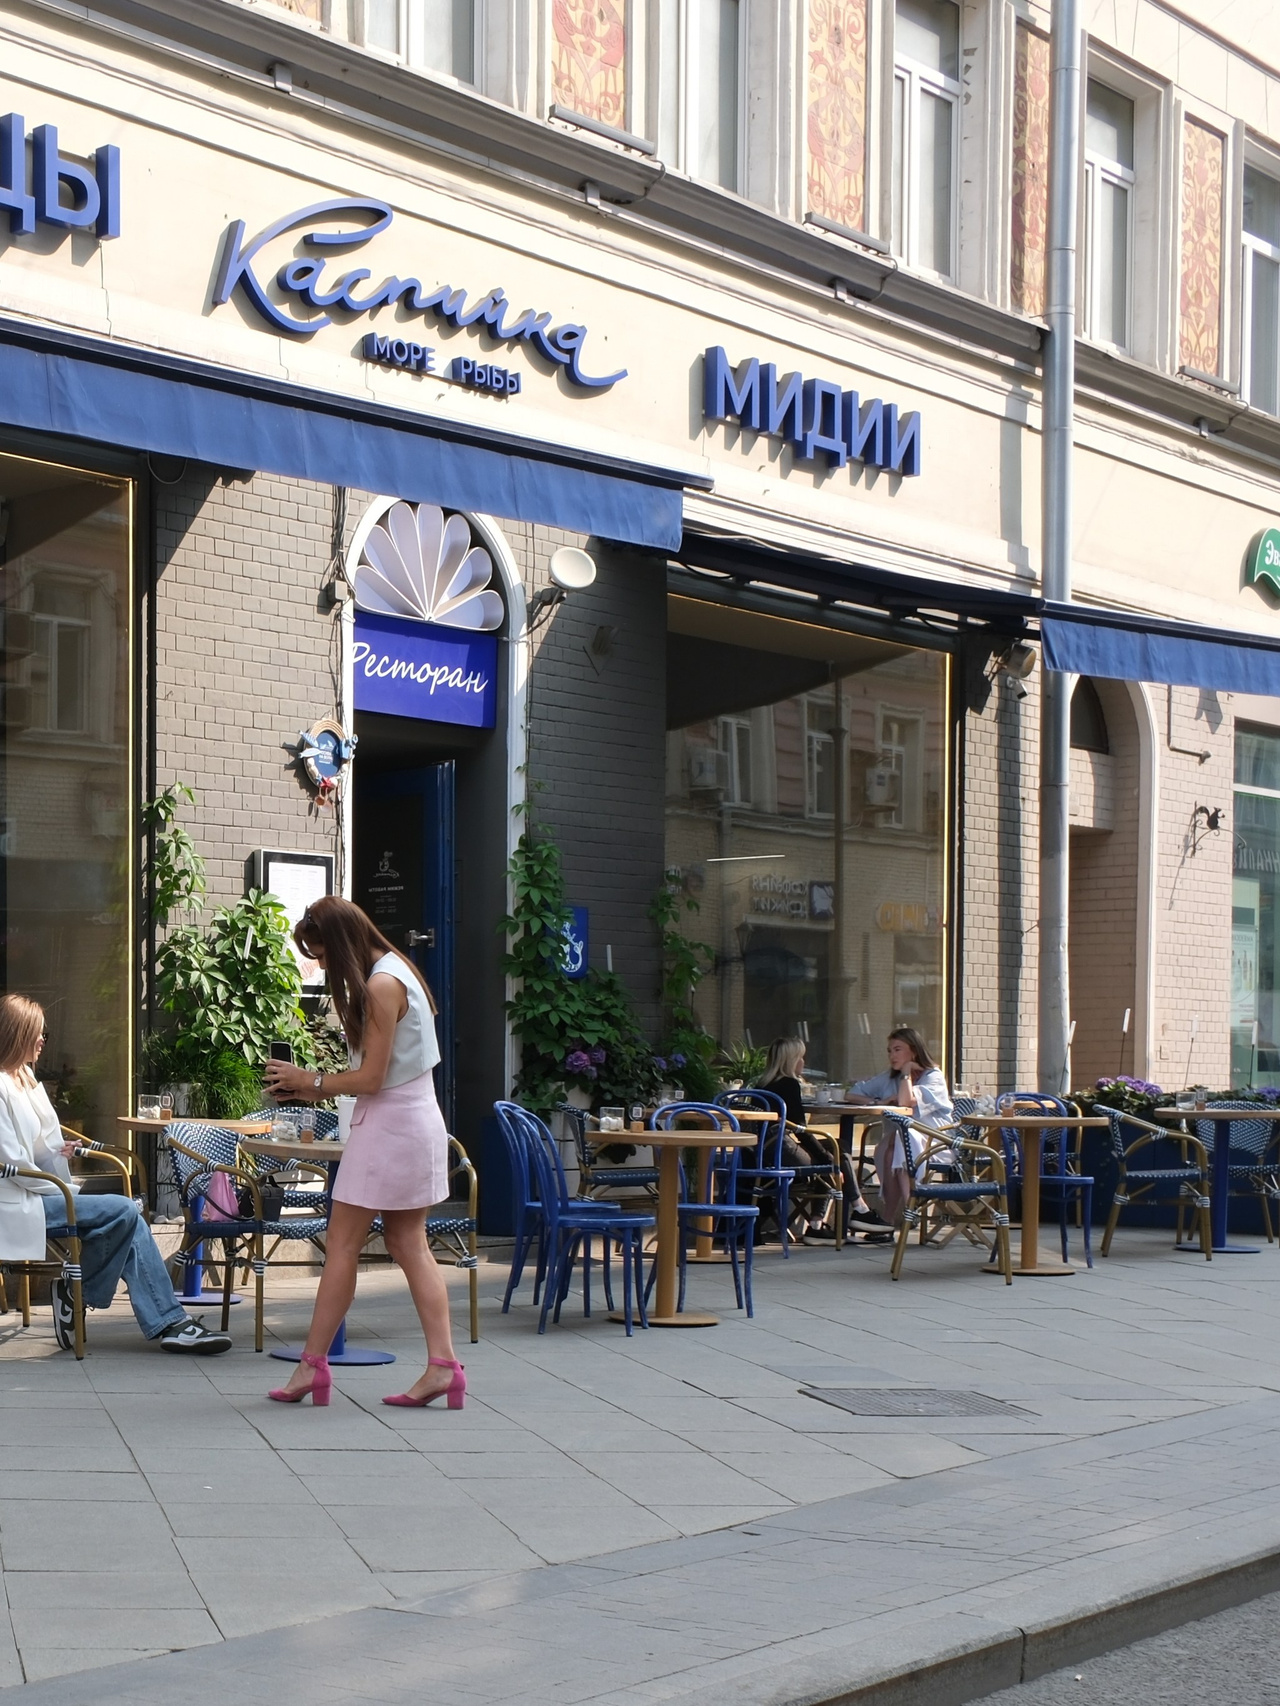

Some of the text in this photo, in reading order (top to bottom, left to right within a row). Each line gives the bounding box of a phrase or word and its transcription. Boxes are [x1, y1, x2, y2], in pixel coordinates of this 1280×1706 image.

[213, 198, 628, 388] Каспийка
[364, 332, 522, 398] МОРЕ РЫБЫ
[704, 345, 922, 478] МИДИИ
[351, 641, 489, 695] Ресторан
